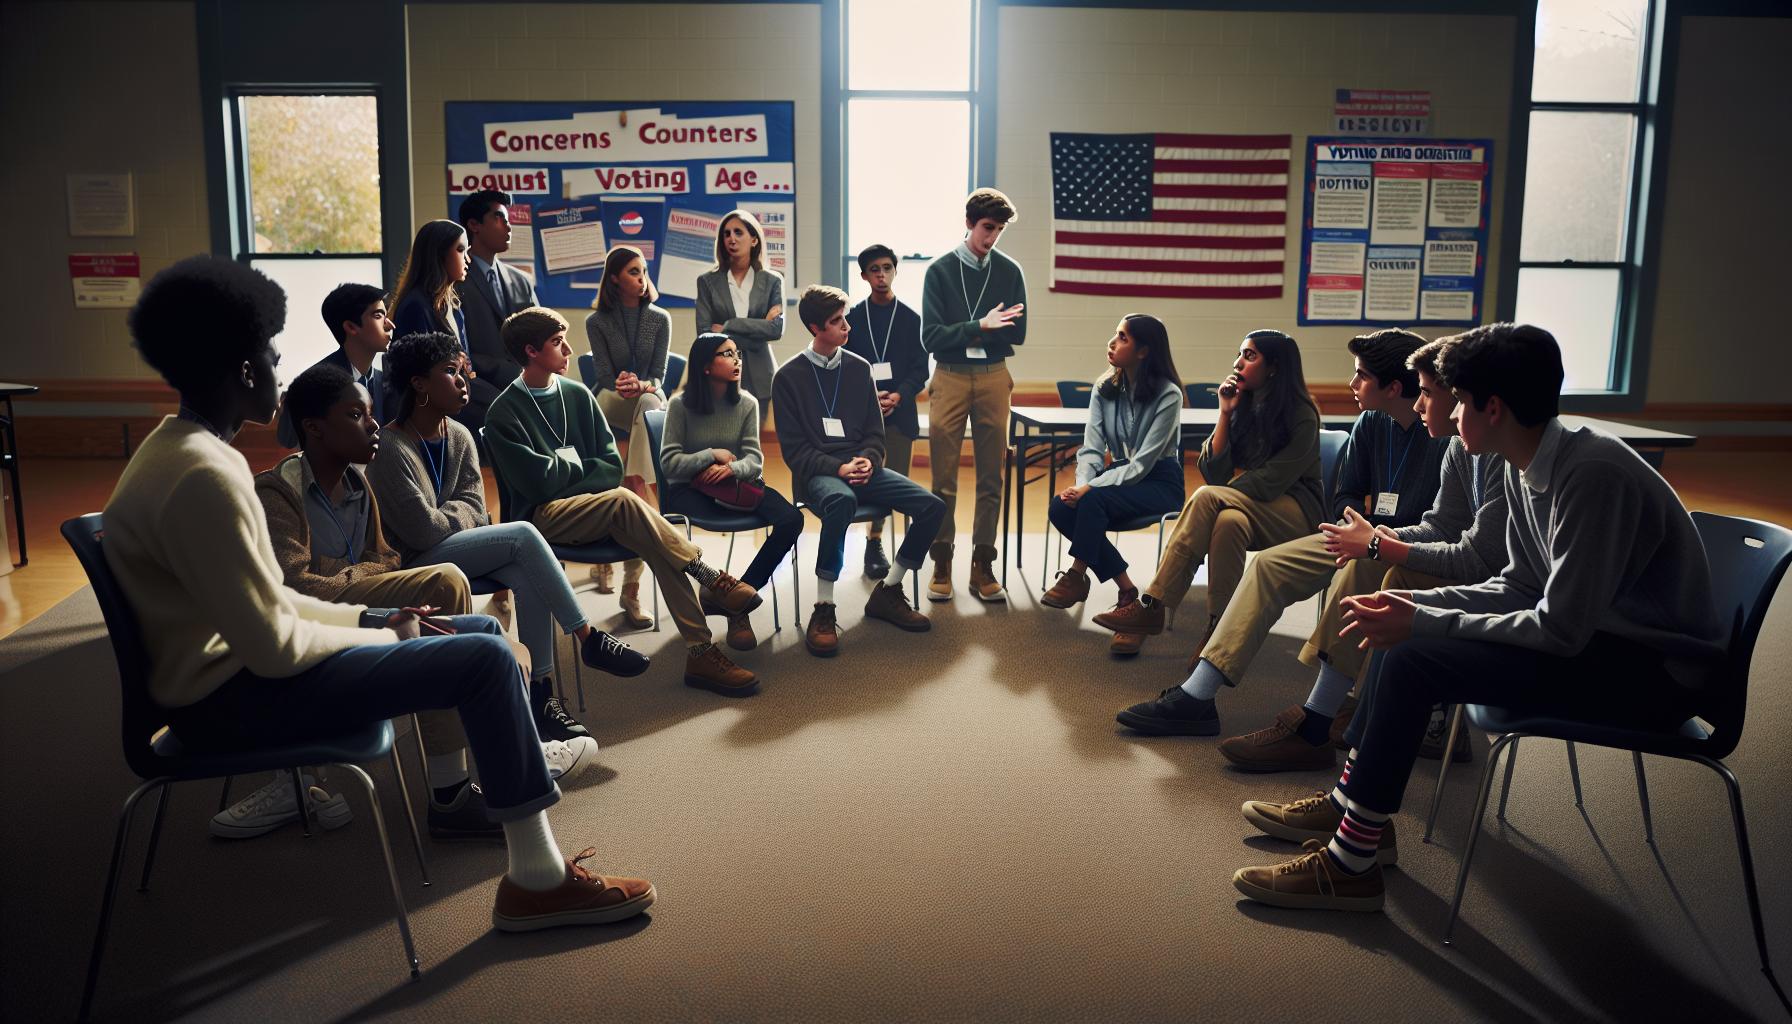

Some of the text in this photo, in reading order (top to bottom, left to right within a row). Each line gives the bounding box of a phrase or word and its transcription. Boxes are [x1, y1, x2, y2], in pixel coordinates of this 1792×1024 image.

[490, 122, 758, 153] Concerns Counters
[594, 168, 686, 192] Voting
